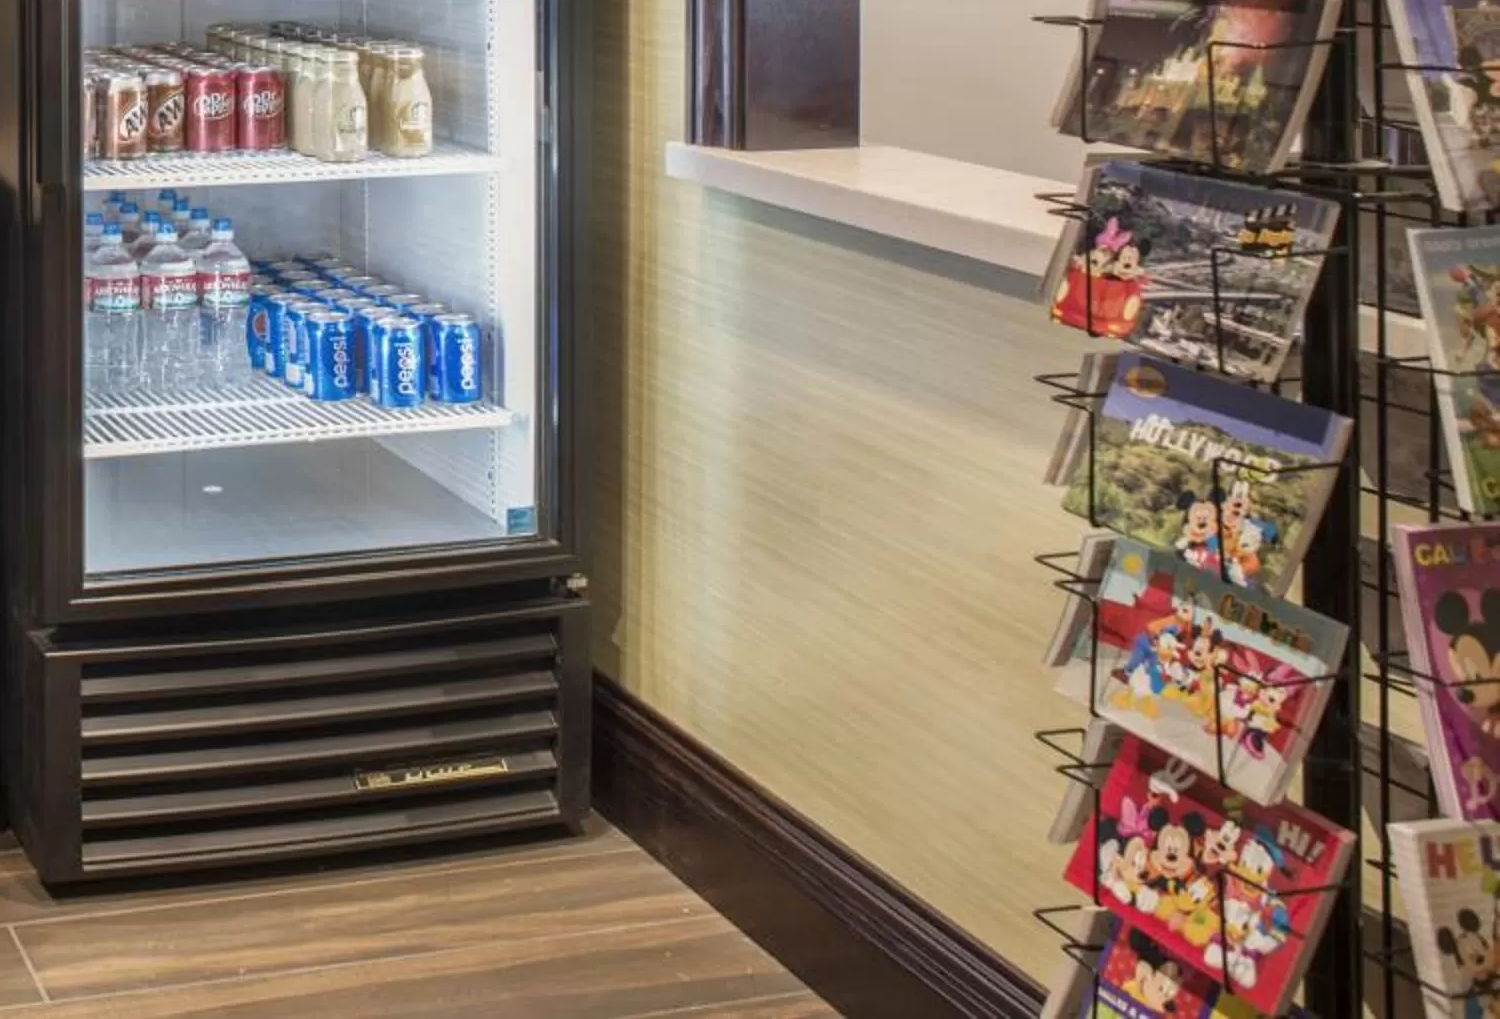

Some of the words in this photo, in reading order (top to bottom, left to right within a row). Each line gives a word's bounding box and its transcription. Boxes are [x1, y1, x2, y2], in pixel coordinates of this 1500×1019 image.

[332, 335, 348, 388] pepsi
[396, 342, 414, 395] pepsi
[460, 337, 477, 391] pepsi
[1427, 834, 1500, 879] HEL
